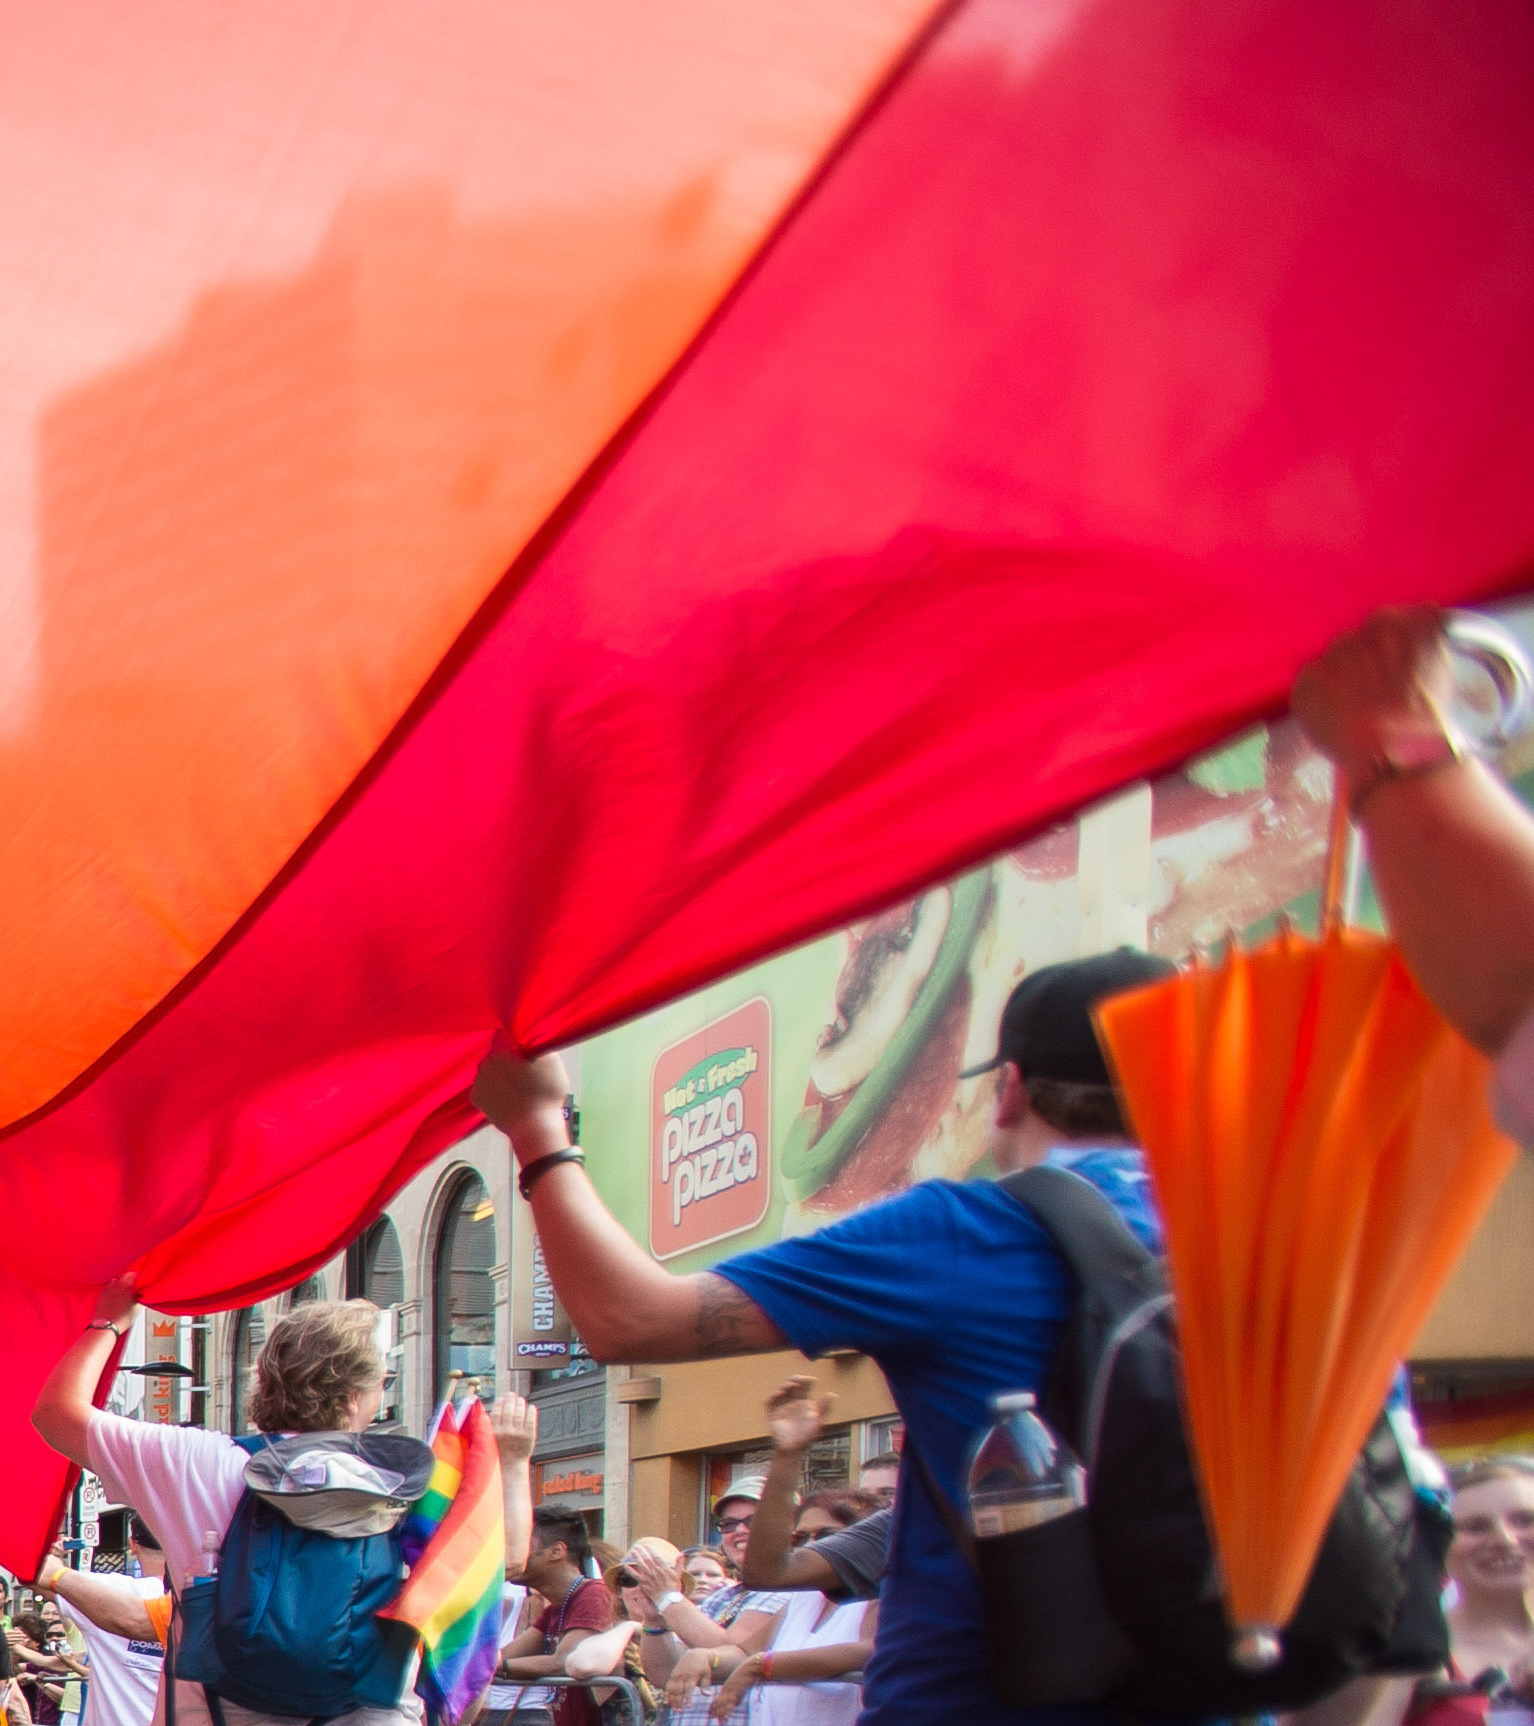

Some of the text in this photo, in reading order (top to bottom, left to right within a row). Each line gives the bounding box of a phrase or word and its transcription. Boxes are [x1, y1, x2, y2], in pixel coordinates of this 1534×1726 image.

[663, 1079, 696, 1116] Hot
[707, 1046, 758, 1094] Fresh
[661, 1087, 744, 1184] pizza
[673, 1132, 758, 1227] pizza
[518, 1343, 566, 1355] CHAMPS
